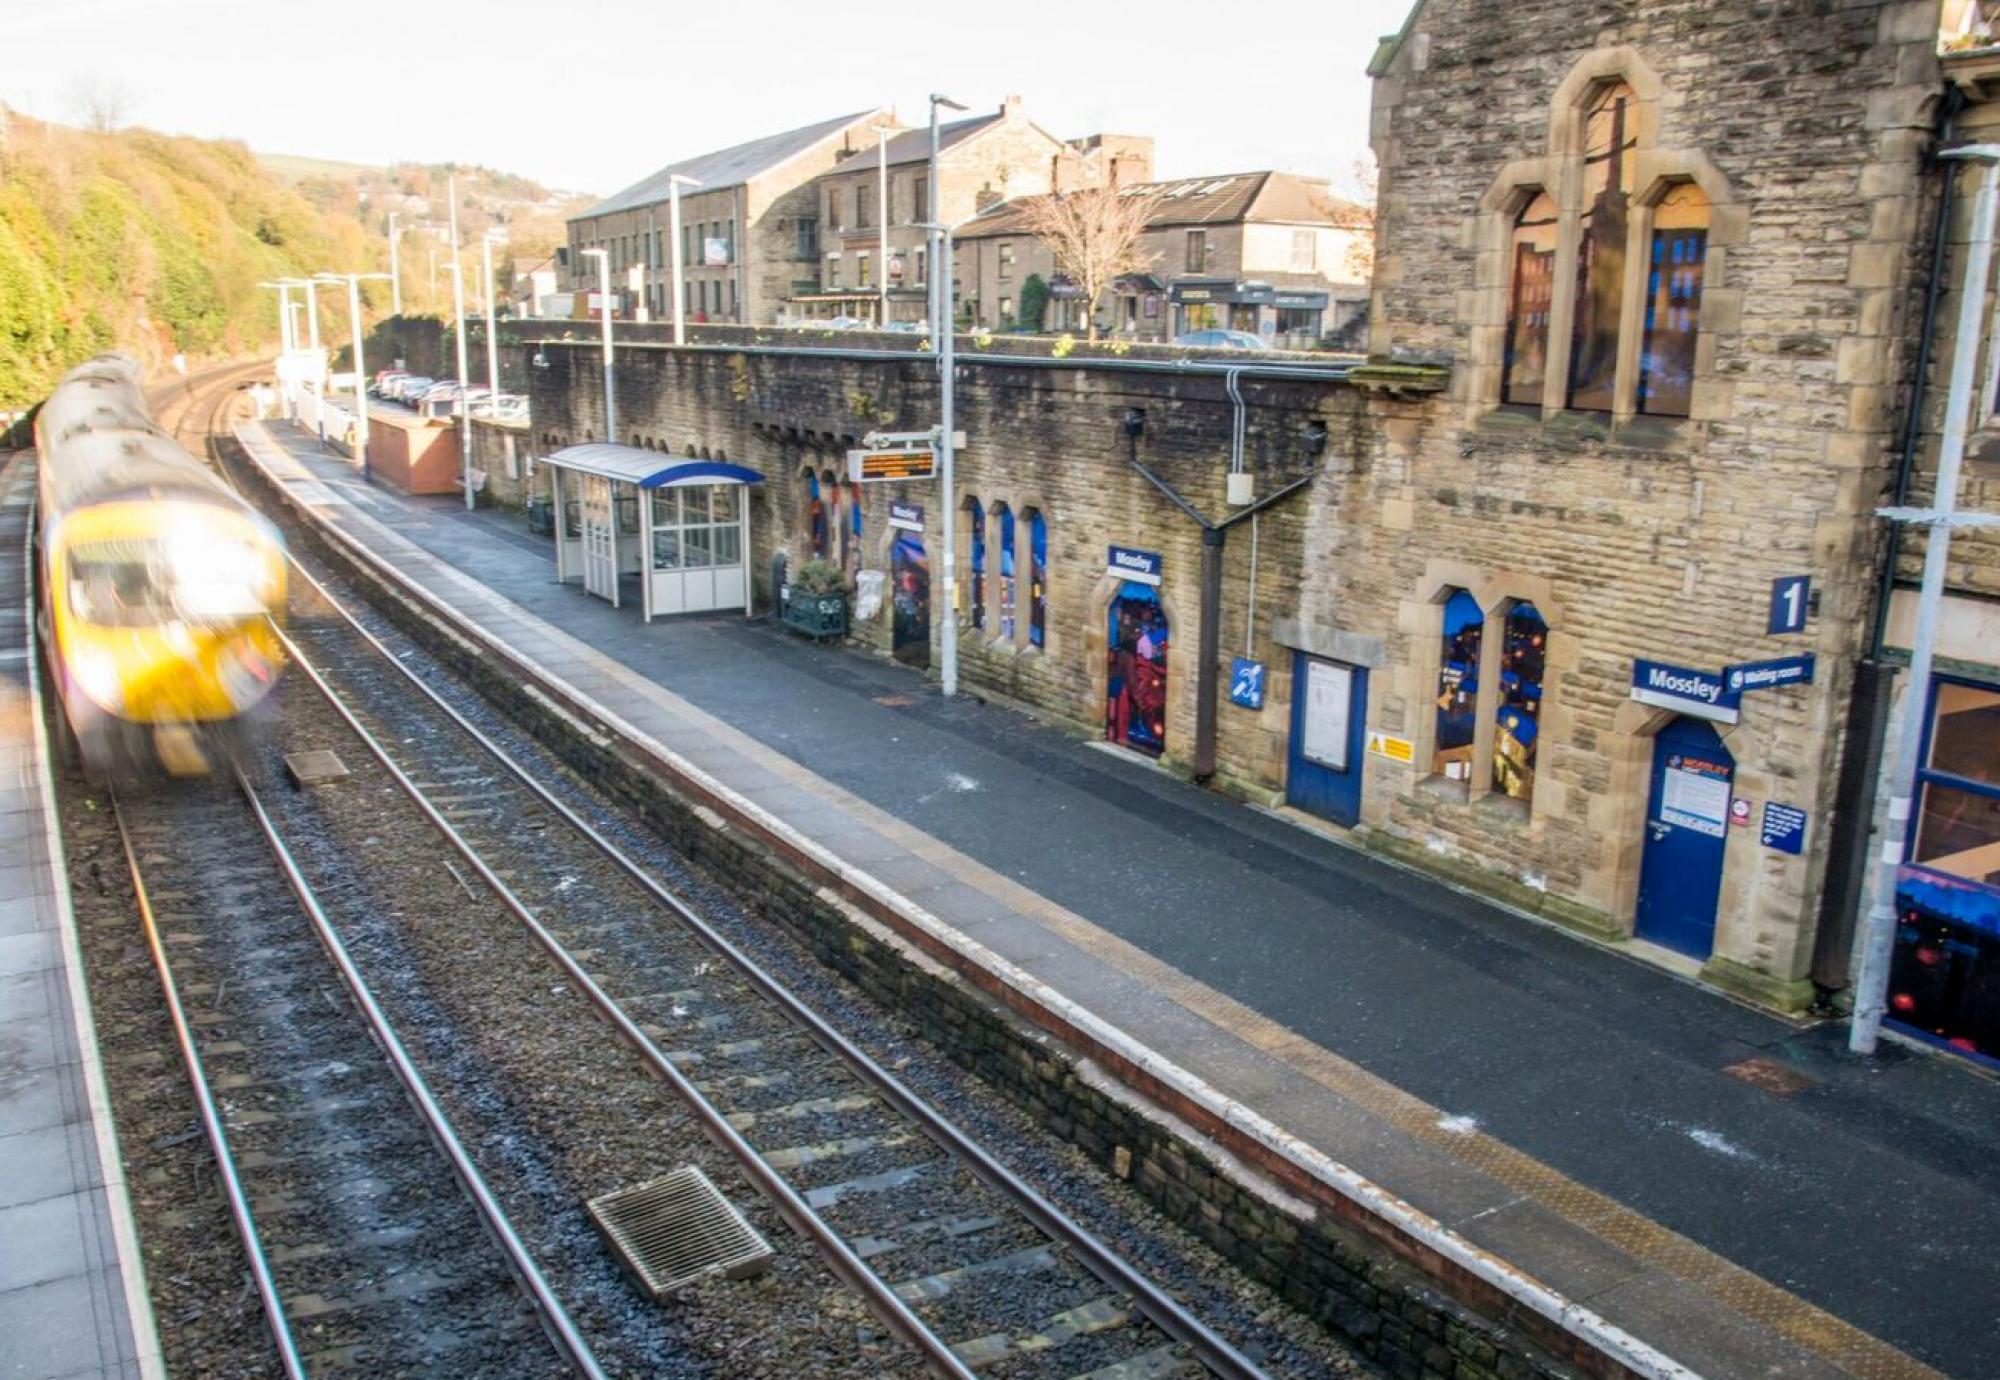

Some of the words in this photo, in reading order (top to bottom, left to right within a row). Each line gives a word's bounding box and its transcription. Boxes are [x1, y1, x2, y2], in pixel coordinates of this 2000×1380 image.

[1116, 552, 1153, 572] Mossley
[1783, 582, 1801, 627] 1
[1649, 668, 1721, 703] Mossley
[1744, 669, 1777, 684] Waiting
[1778, 666, 1804, 678] room
